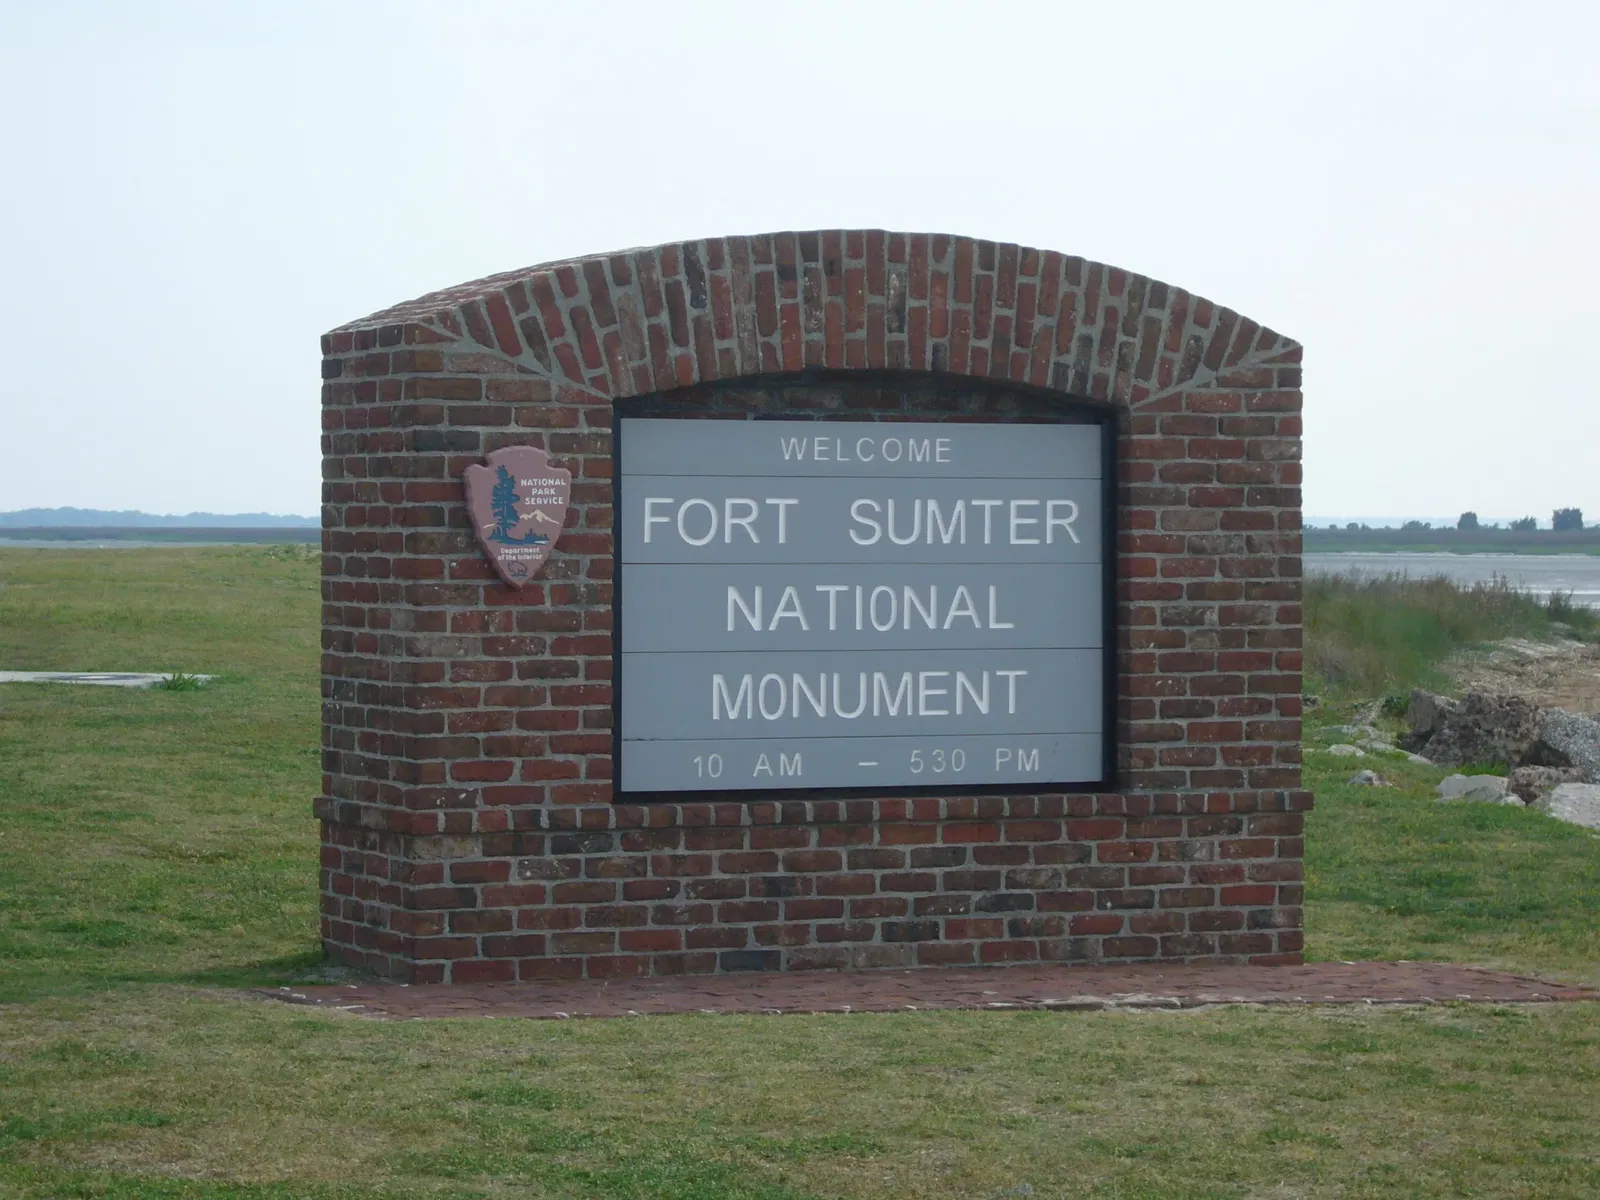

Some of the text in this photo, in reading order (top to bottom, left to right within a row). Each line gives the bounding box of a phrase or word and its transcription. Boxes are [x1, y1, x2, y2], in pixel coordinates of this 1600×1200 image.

[780, 436, 953, 463] WELCOME
[520, 478, 566, 486] NATIONAL
[643, 496, 1081, 547] FORT SUMTER
[726, 584, 1015, 632] NATIONAL
[711, 670, 1029, 720] MONUMENT
[693, 753, 723, 778] 10
[752, 752, 803, 777] AM
[909, 748, 966, 773] 530
[995, 747, 1041, 772] PM
